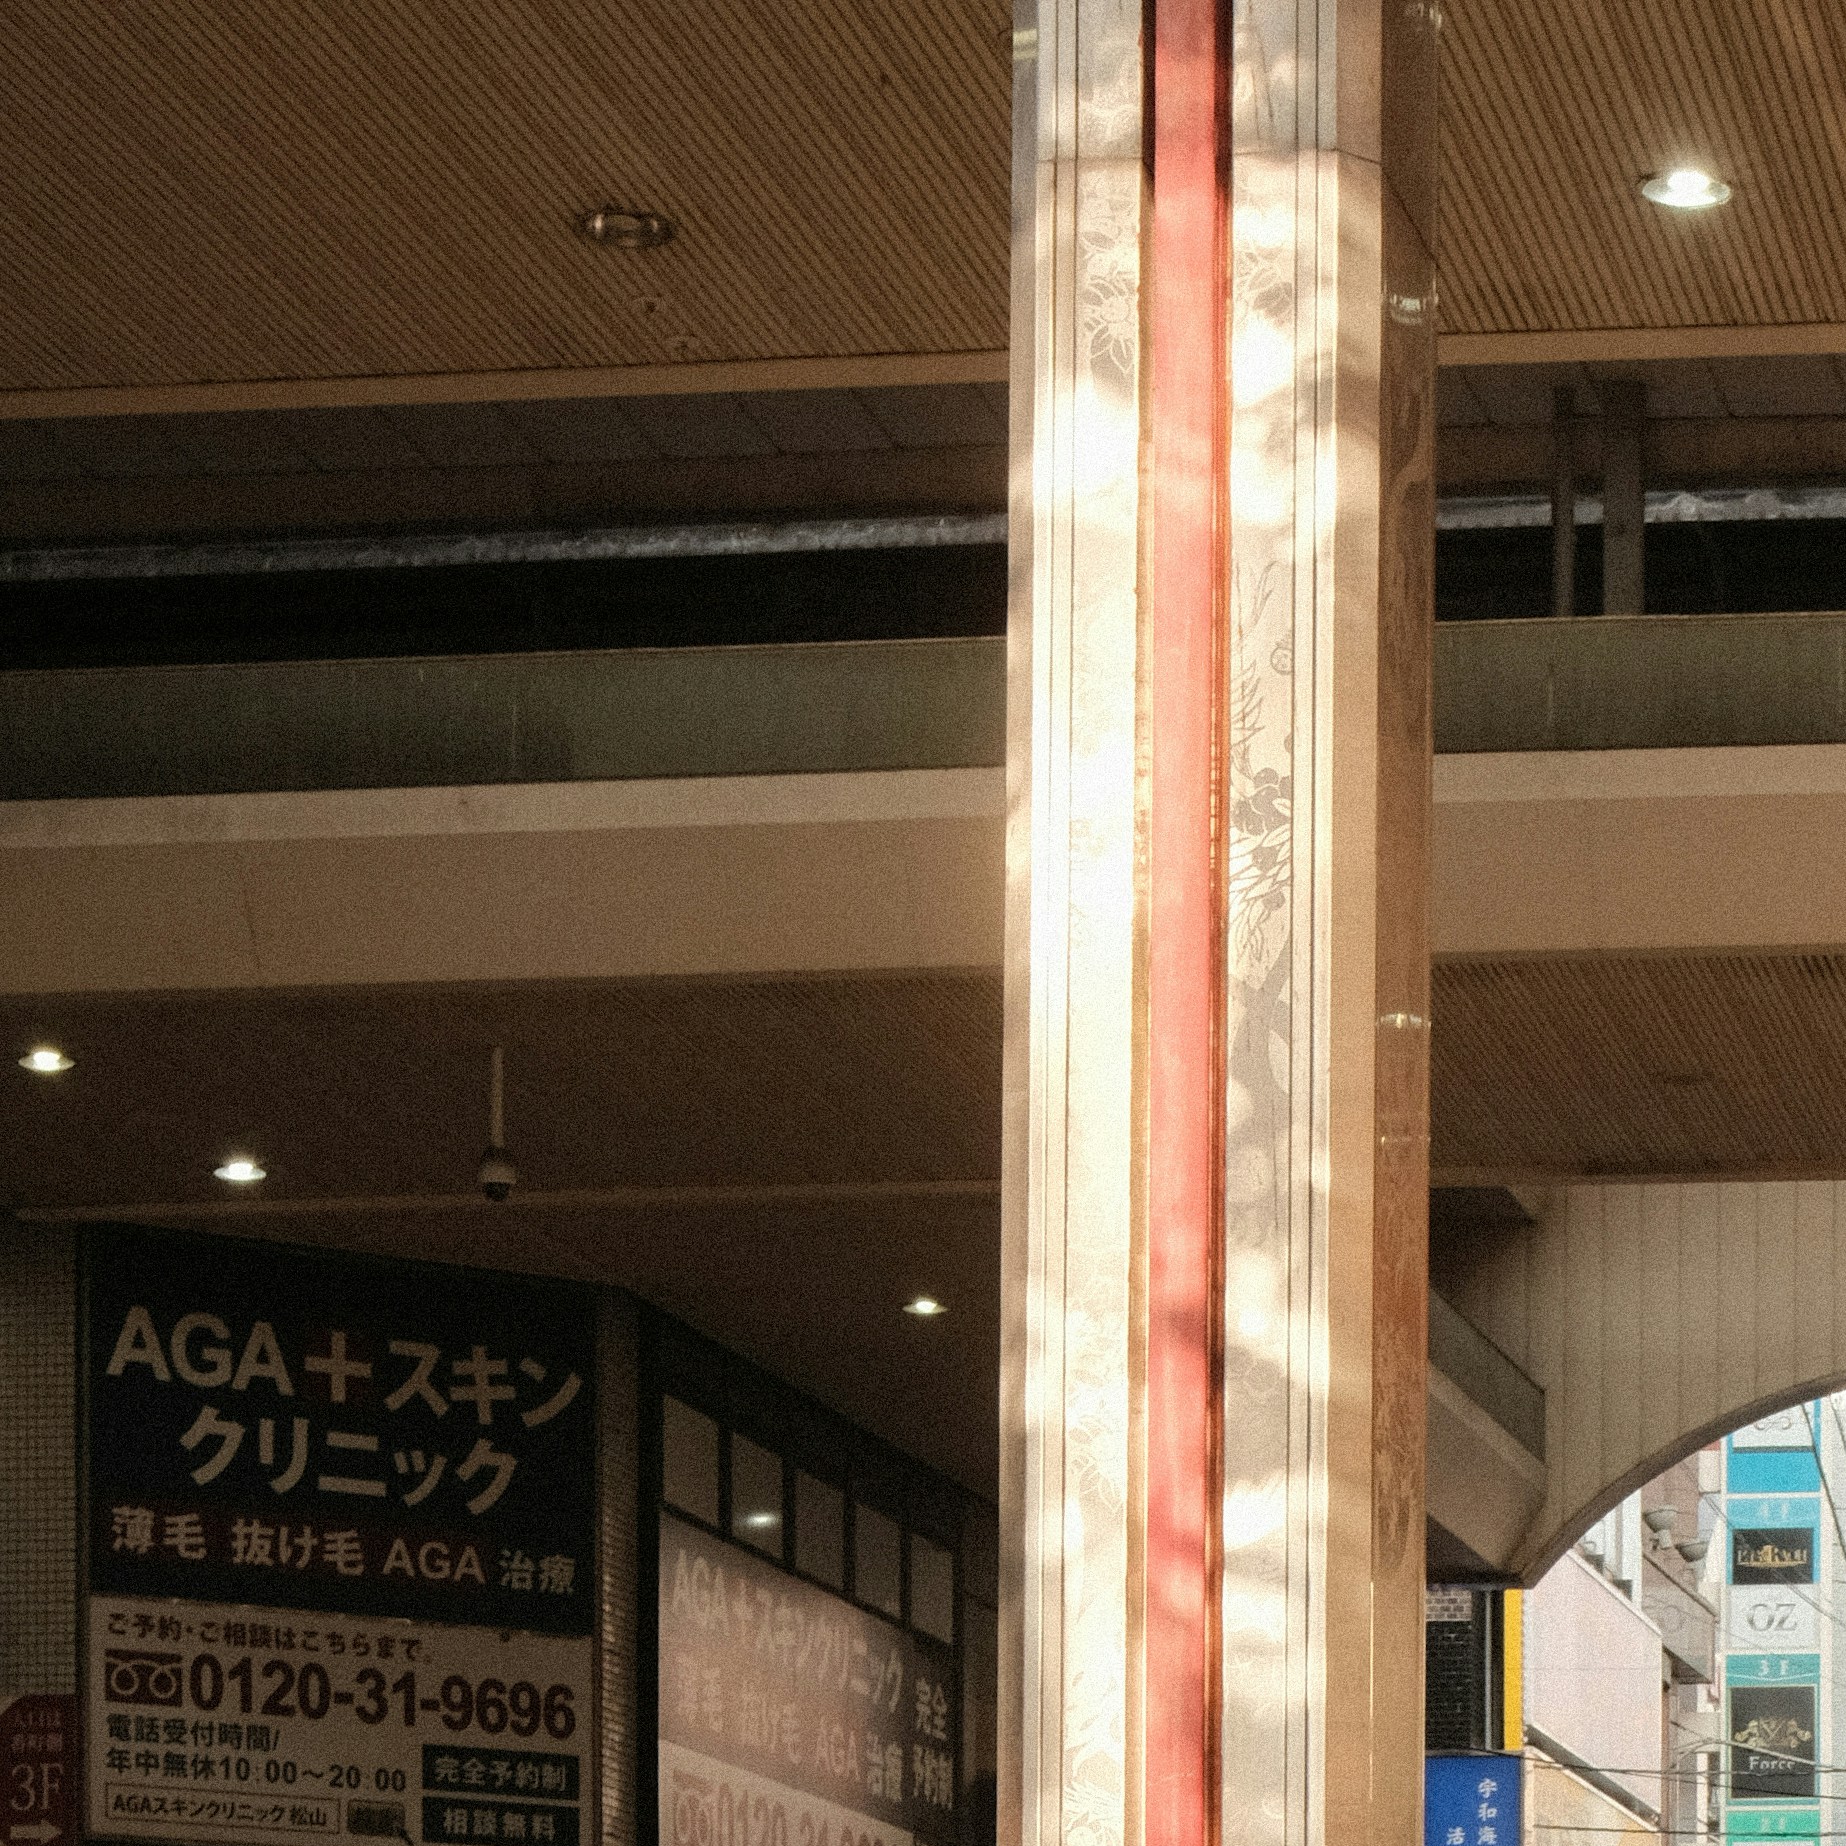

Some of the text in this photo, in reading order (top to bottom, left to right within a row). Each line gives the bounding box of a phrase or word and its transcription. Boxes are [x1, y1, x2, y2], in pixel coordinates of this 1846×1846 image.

[179, 1406, 518, 1517] クリニック
[111, 1506, 577, 1595] 薄毛 抜け毛 AGA 治療
[1746, 1603, 1798, 1632] OZ
[189, 1653, 576, 1740] 0120-31-9696
[107, 1712, 281, 1753] 電話受付時間/
[433, 1755, 567, 1792] 完全予約制
[1748, 1755, 1796, 1771] Force
[9, 1762, 65, 1813] 3F
[289, 1806, 328, 1827] 松山
[442, 1806, 556, 1841] 相談無料
